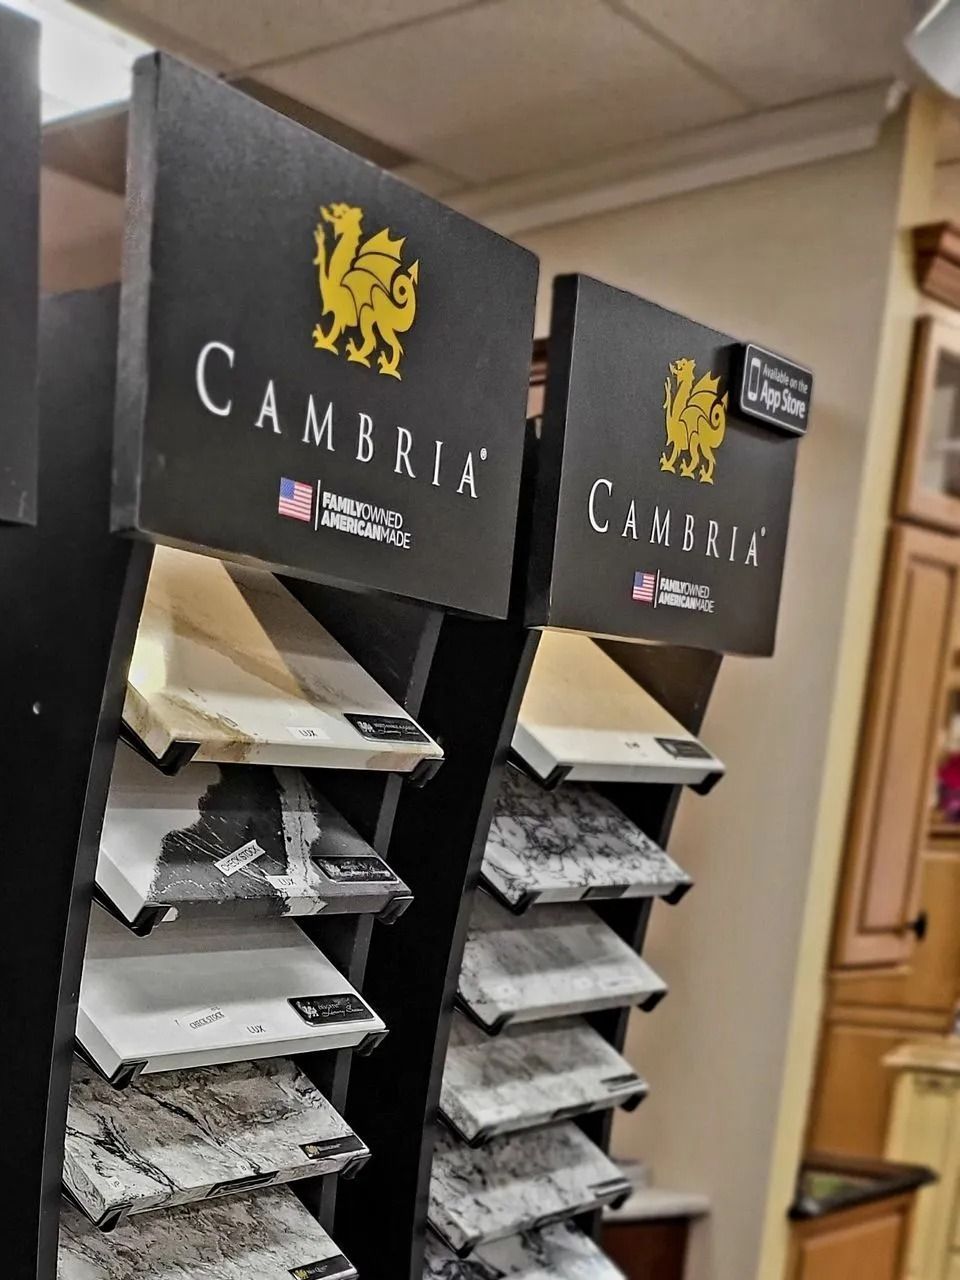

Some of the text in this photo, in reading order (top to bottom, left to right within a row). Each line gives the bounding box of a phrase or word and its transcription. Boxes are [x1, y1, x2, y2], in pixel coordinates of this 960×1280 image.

[763, 363, 809, 394] Available on the
[760, 380, 806, 419] App Store
[299, 729, 319, 738] LUX
[246, 1025, 266, 1034] LUX
